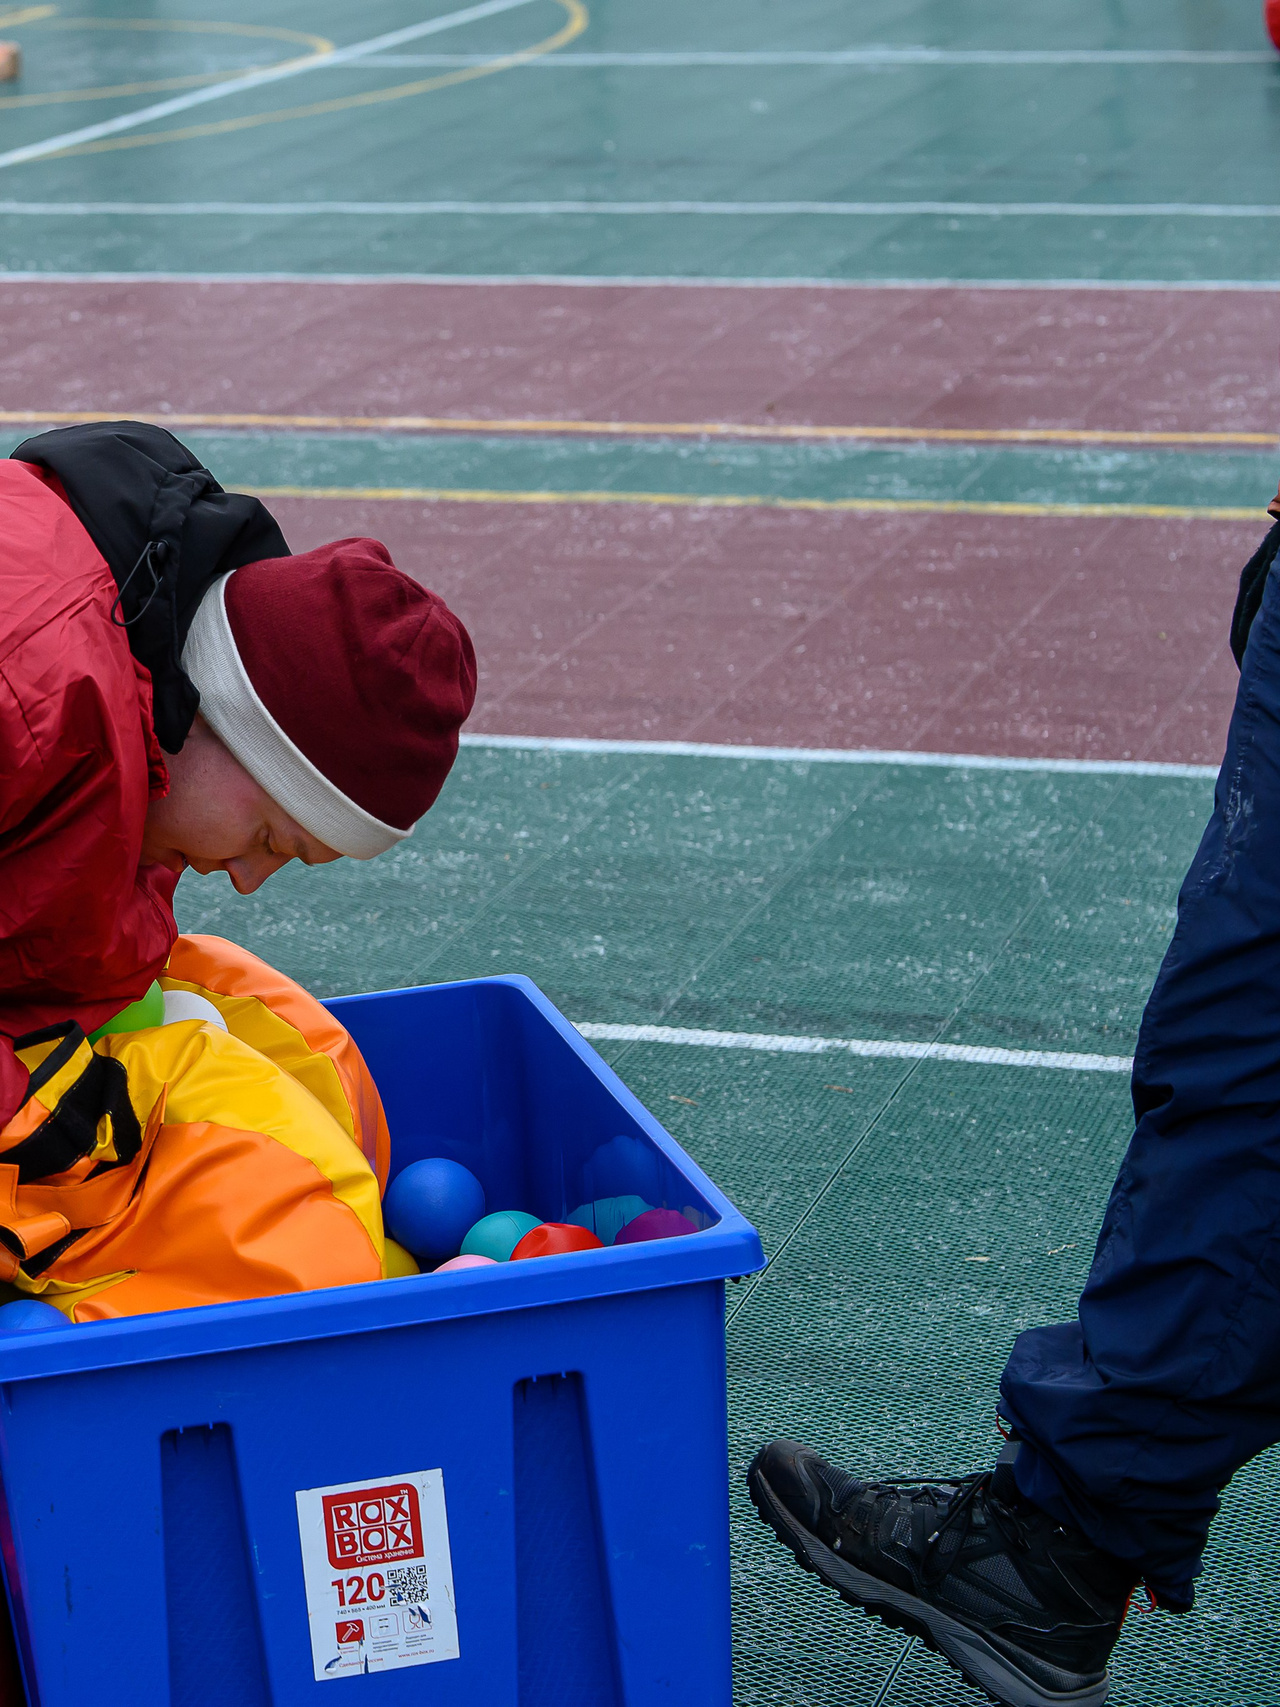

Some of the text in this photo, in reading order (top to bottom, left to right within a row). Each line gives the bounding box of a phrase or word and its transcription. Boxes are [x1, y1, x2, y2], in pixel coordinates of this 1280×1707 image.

[333, 1496, 409, 1530] ROX
[336, 1523, 412, 1557] BOX
[356, 1548, 414, 1563] Система хранения
[332, 1573, 385, 1606] 120
